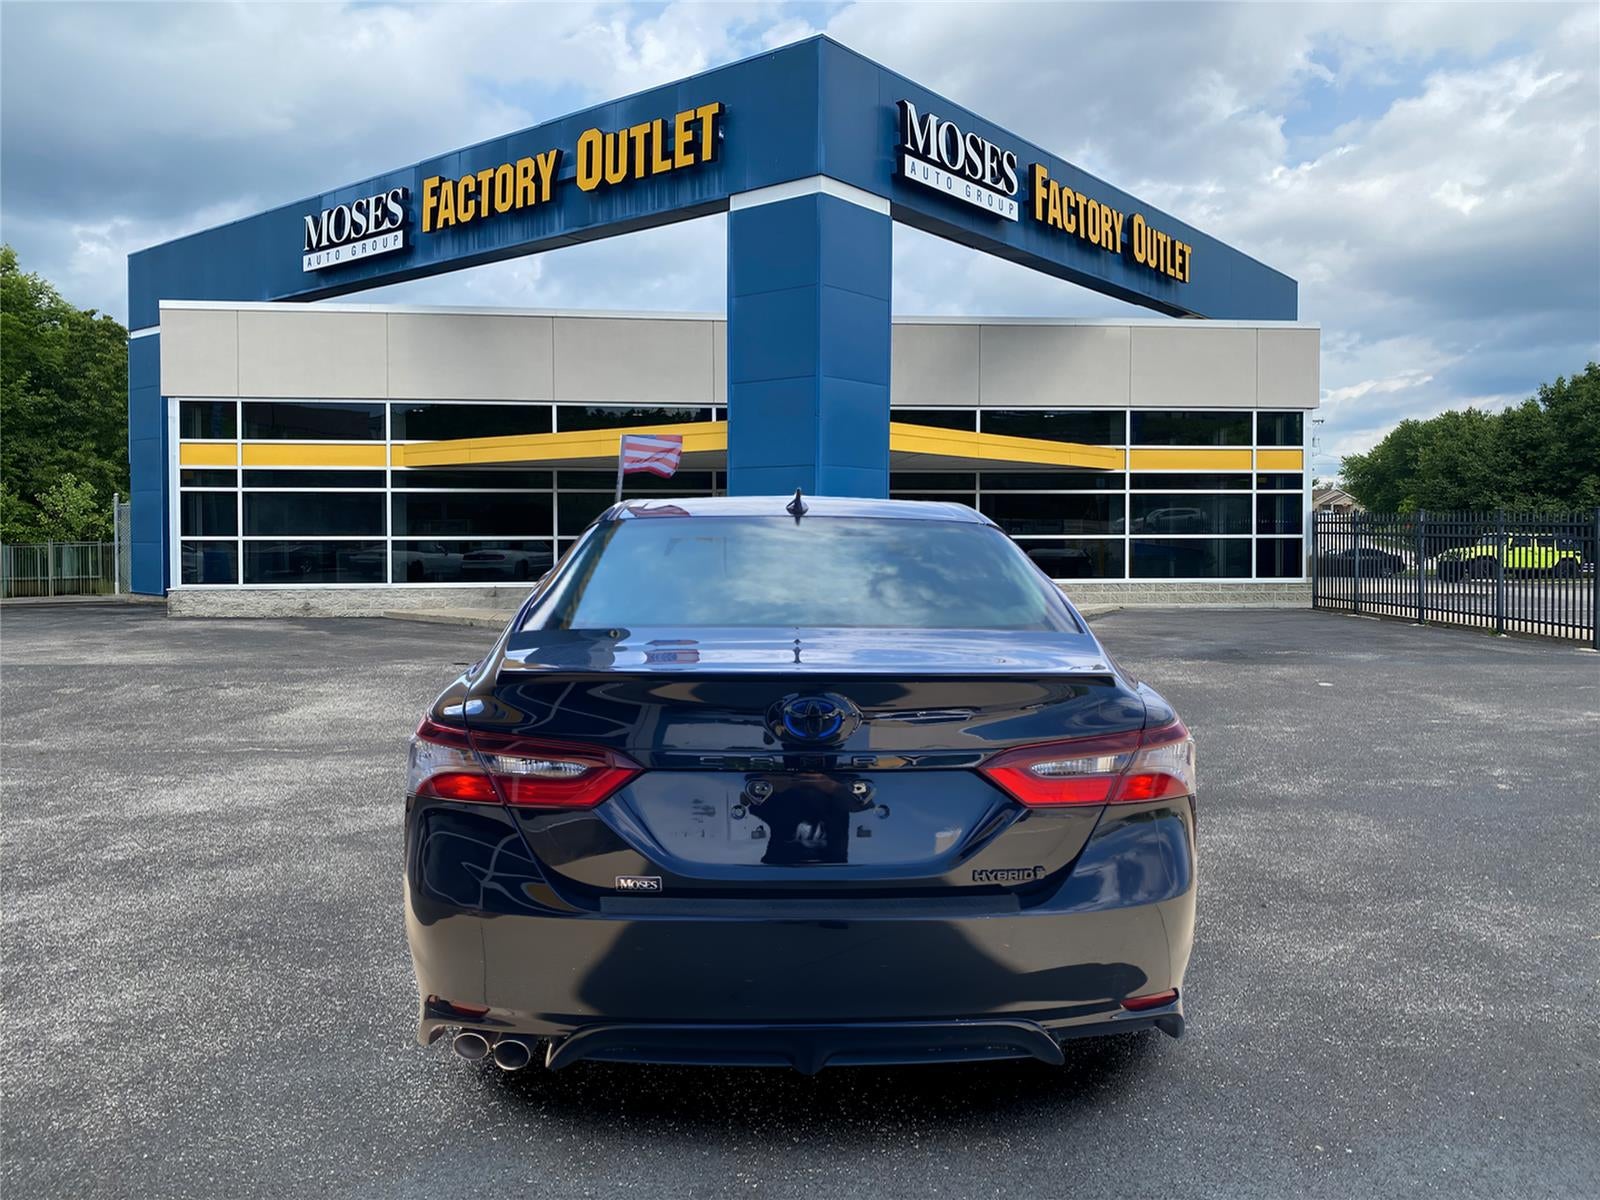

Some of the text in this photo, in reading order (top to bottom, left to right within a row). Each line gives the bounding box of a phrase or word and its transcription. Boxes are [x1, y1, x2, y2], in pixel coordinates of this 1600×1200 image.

[421, 102, 720, 233] FACTORY OUTLET
[903, 100, 1018, 196] MOSES
[909, 161, 1015, 215] AUTO GROUP
[303, 187, 404, 251] MOSES
[1034, 163, 1192, 284] FACTORY OUTLET
[307, 235, 399, 267] AUTO GROUP
[620, 879, 658, 890] MOSES
[972, 868, 1034, 881] HYBRID
